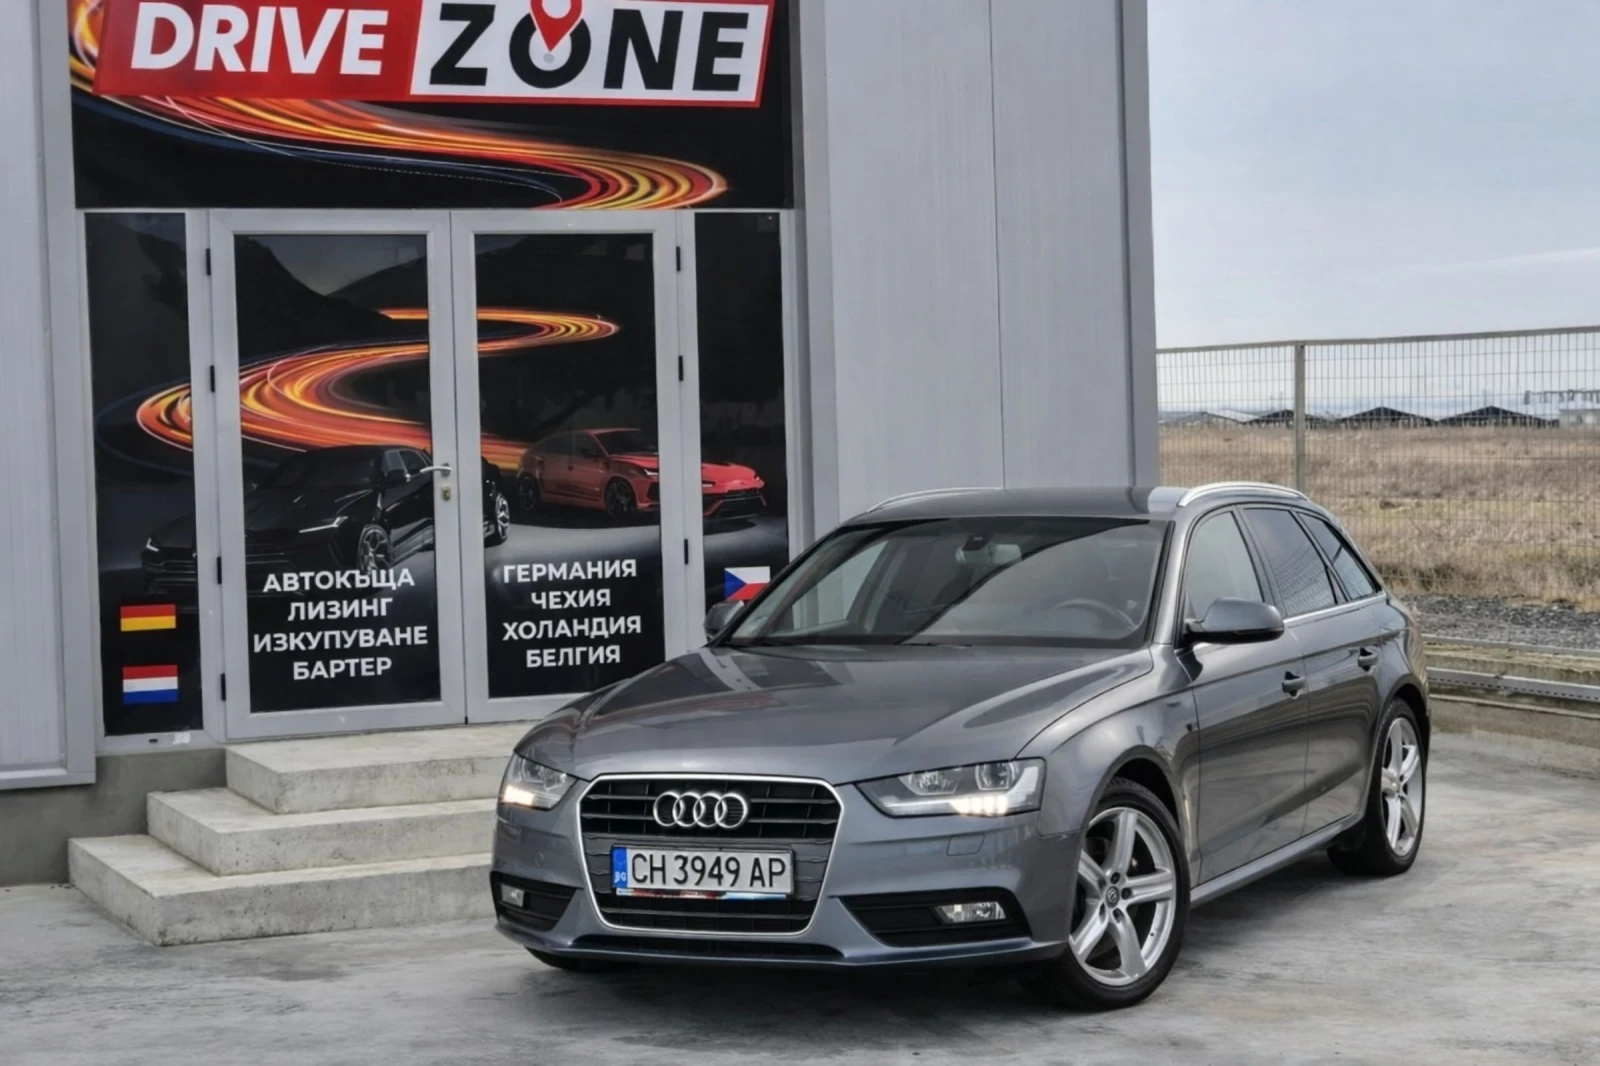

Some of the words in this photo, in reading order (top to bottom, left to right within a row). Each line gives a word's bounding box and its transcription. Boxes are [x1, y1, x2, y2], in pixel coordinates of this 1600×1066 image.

[131, 2, 389, 76] DRIVE
[429, 2, 749, 91] ZONE
[262, 568, 415, 593] АВТОКЪЩА
[503, 559, 637, 583] ГЕРМАНИЯ
[287, 598, 393, 621] ЛИЗИНГ
[531, 589, 611, 609] ЧЕХИЯ
[253, 626, 428, 653] ИЗКУПУВАНЕ
[502, 615, 642, 641] ХОЛАНДИЯ
[293, 657, 392, 680] БАРТЕР
[526, 645, 621, 668] БЕЛГИЯ
[632, 853, 666, 885] CH
[673, 854, 741, 887] 3949
[749, 857, 786, 888] AP
